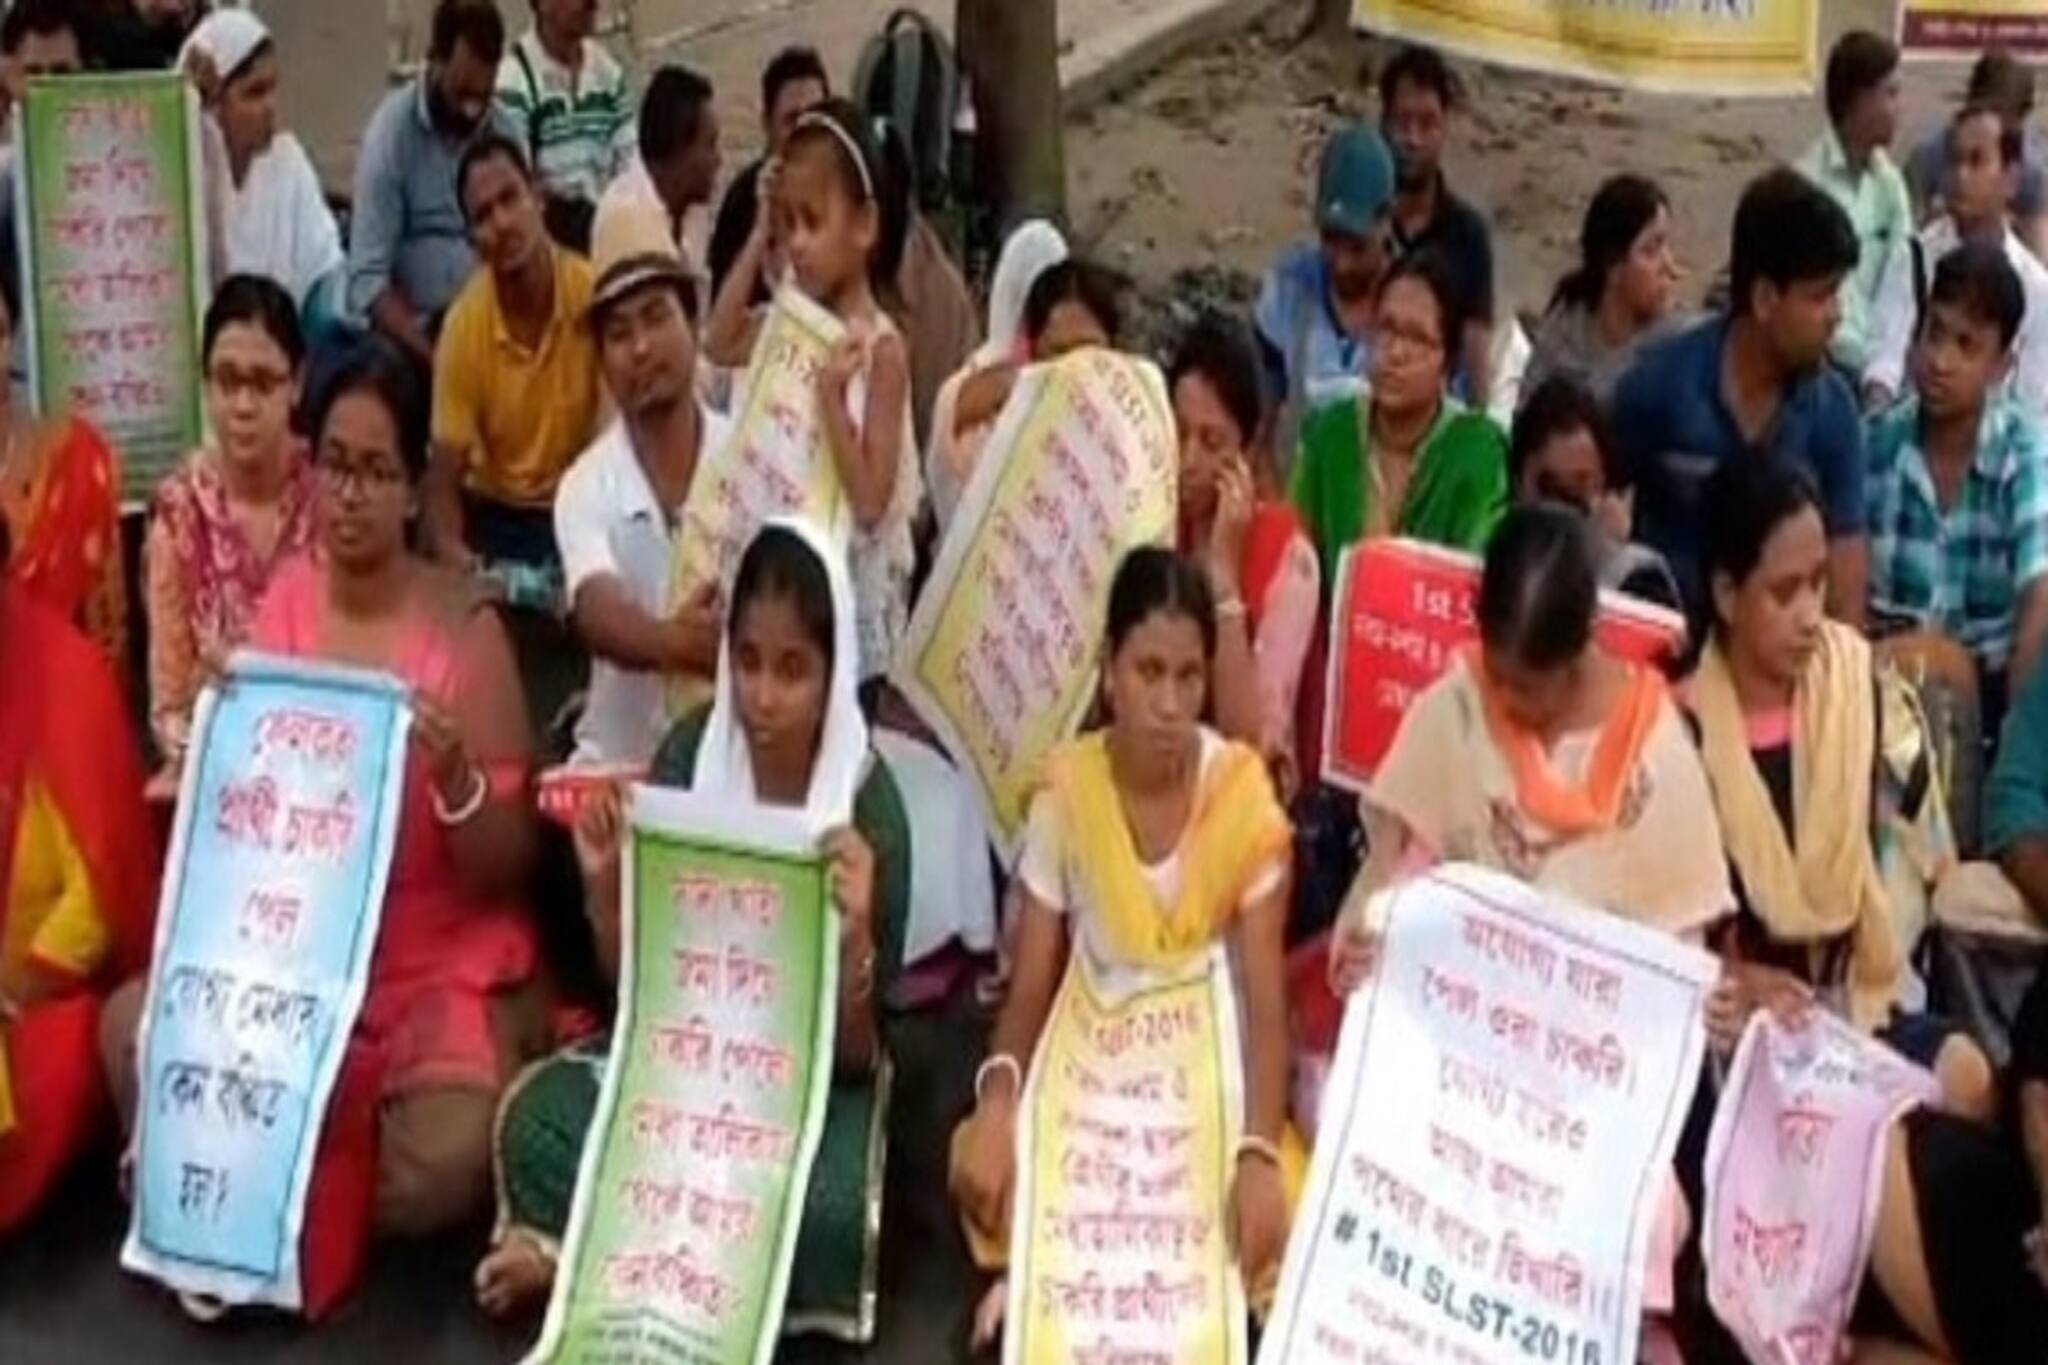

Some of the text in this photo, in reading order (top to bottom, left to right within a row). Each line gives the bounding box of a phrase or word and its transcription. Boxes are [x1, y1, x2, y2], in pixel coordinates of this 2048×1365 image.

[1458, 913, 1625, 1013] অযোগ্য যারা
[1365, 1230, 1413, 1288] 1st
